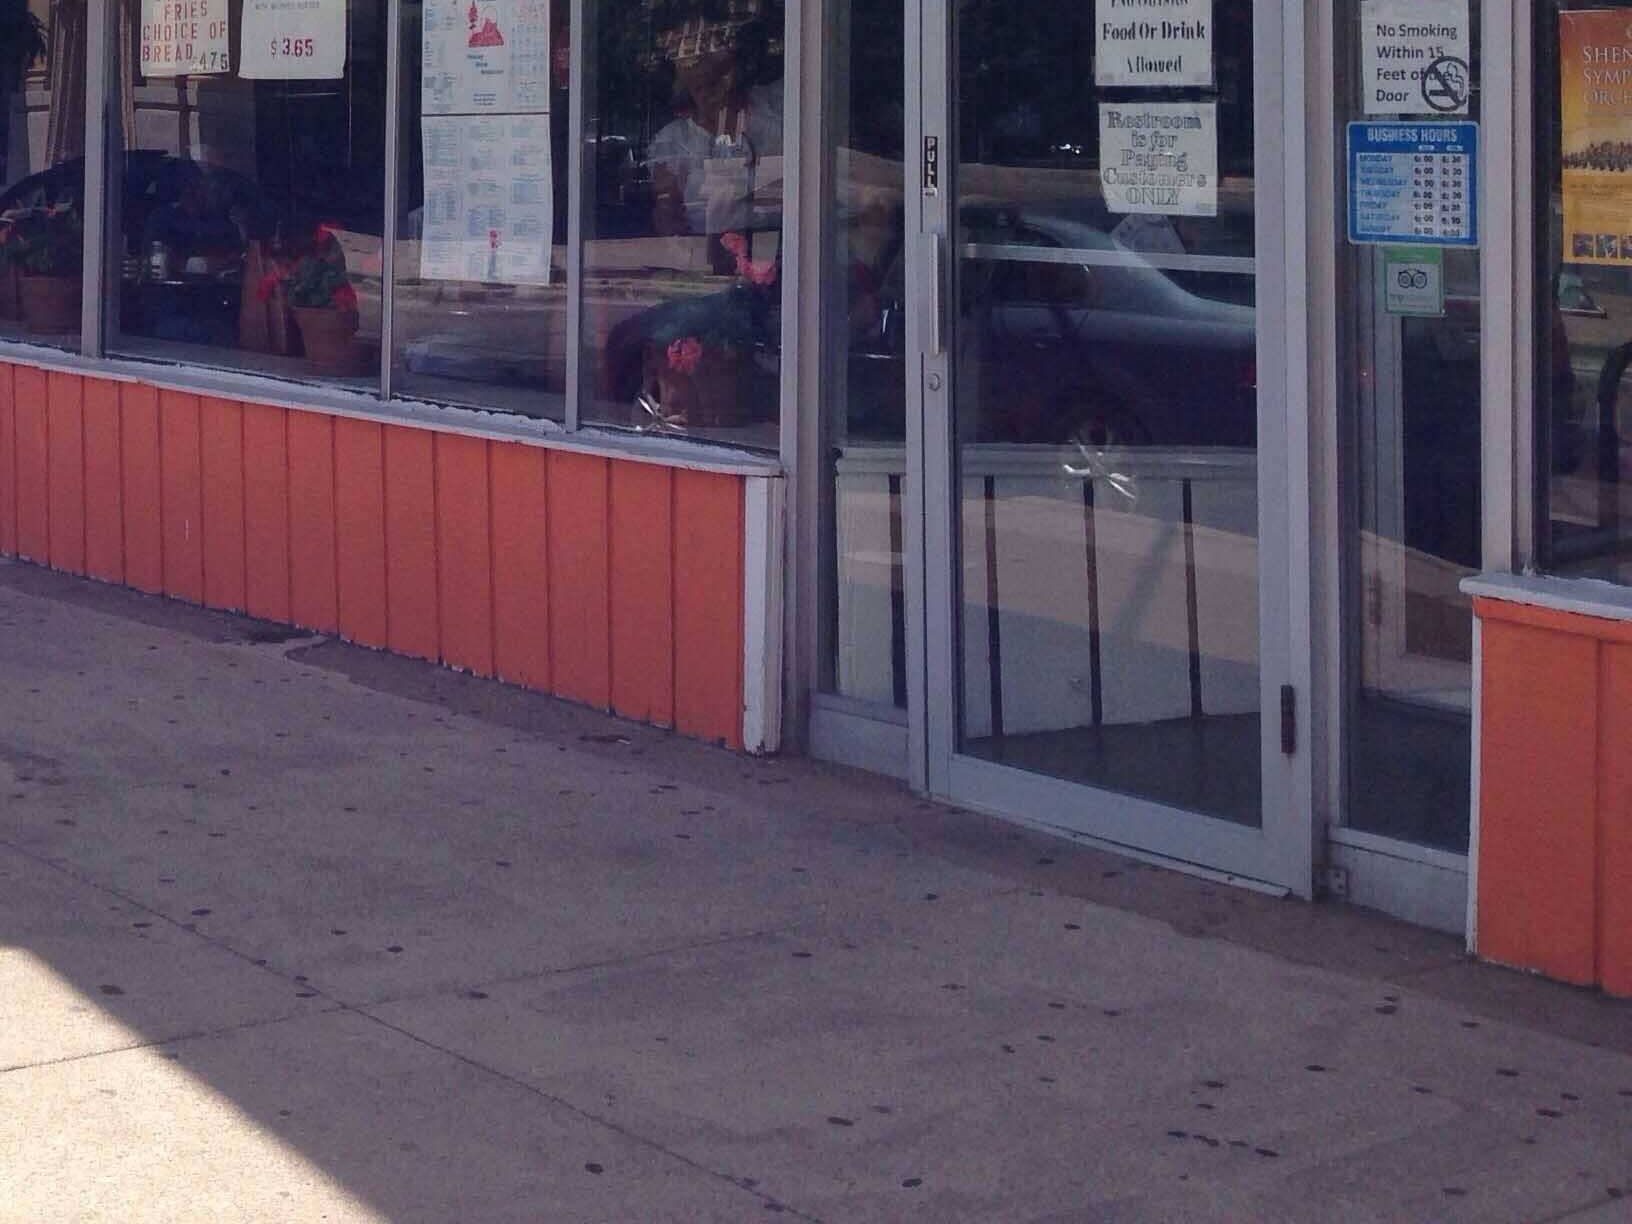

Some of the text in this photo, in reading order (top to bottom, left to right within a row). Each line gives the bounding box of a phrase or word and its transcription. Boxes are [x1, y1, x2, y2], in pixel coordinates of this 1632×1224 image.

[164, 1, 207, 21] FRIES
[143, 21, 226, 41] CHOICE OF
[1103, 19, 1205, 40] Food Or Drink
[1376, 23, 1457, 40] No Smoking
[142, 43, 192, 63] BREAD
[1376, 45, 1444, 58] Within 15
[1125, 55, 1182, 73] Allowed
[1376, 67, 1406, 80] Feet
[1410, 67, 1426, 80] of
[1376, 89, 1409, 102] Door
[1107, 111, 1202, 129] Restroom
[1131, 130, 1178, 151] is for
[1367, 127, 1457, 142] BUSINESS HOURS
[927, 137, 936, 188] PULL
[1120, 149, 1188, 172] Paying
[1103, 167, 1207, 187] Customers
[1126, 187, 1179, 205] ONLY
